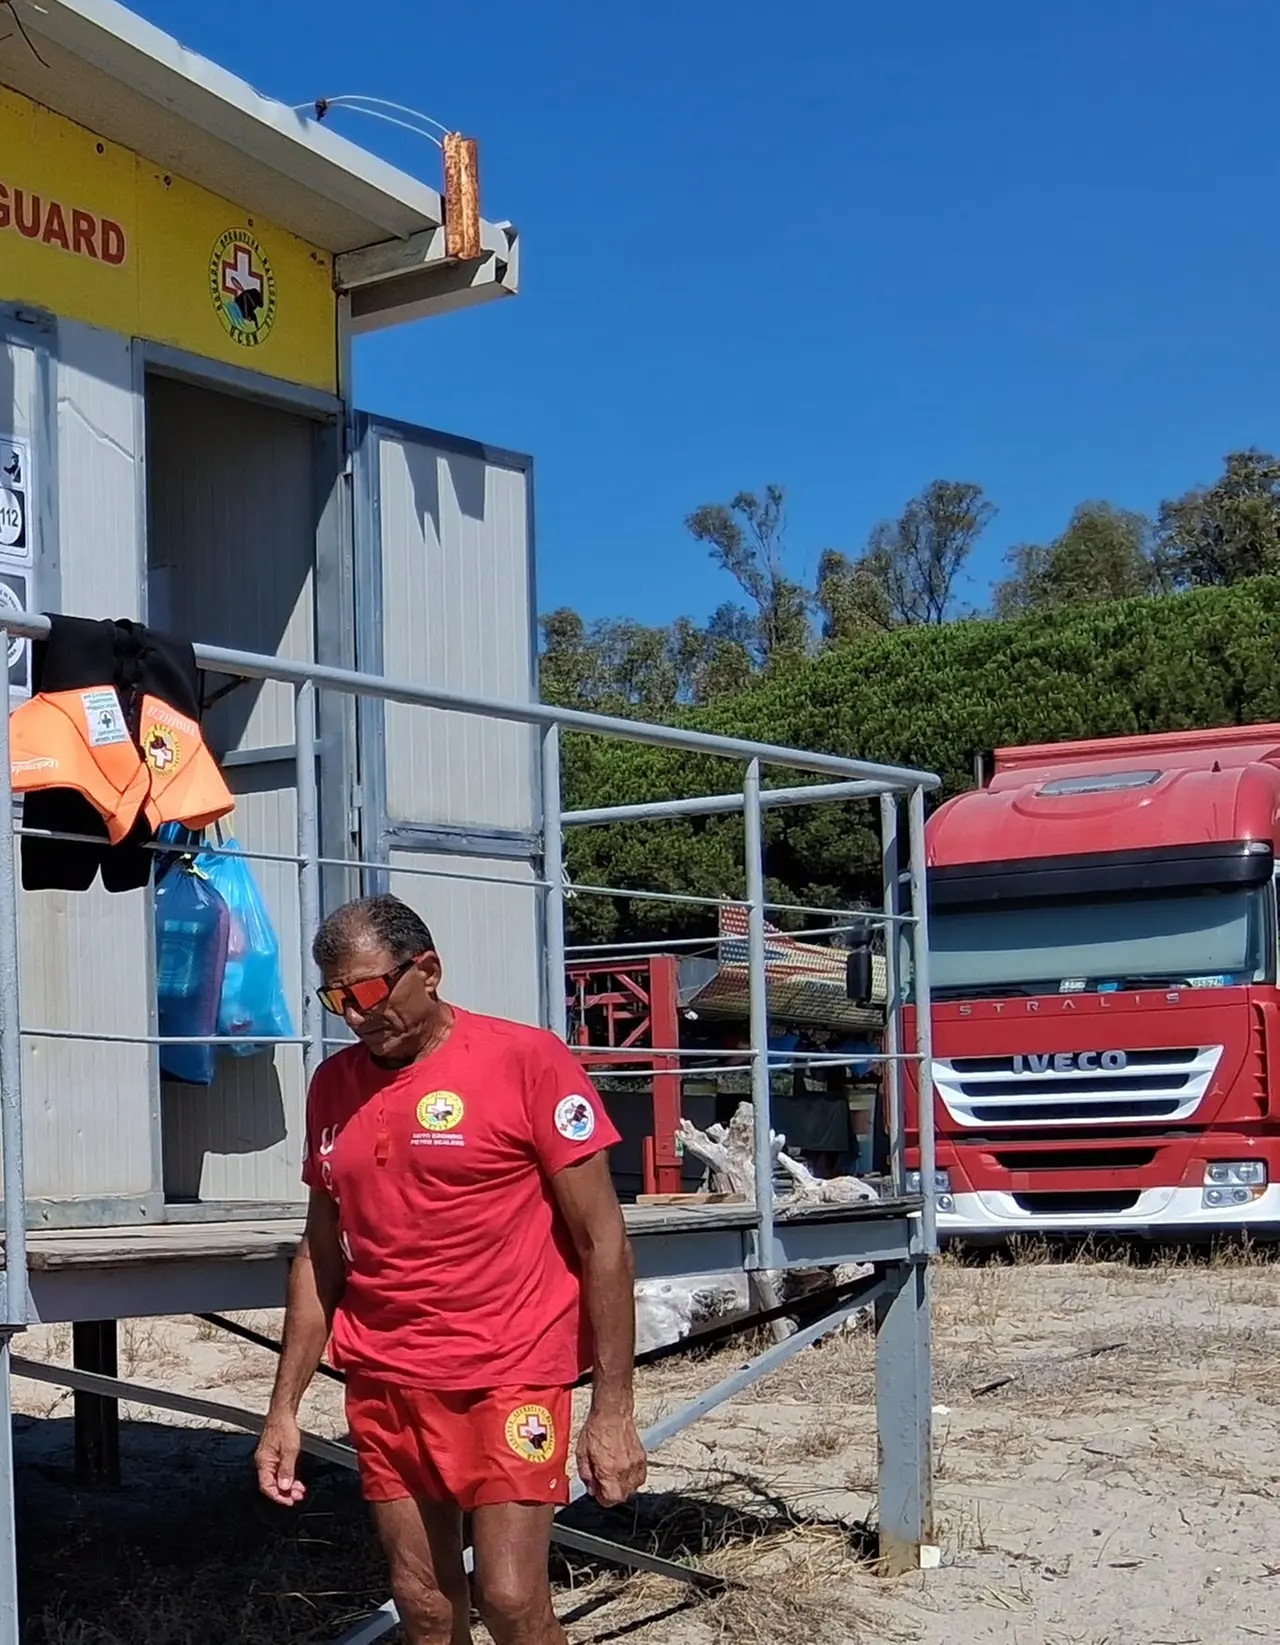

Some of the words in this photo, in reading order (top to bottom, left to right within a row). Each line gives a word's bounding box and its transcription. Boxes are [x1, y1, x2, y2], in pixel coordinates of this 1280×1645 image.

[0, 508, 19, 528] 112
[959, 992, 1180, 1016] STRALIS
[1012, 1050, 1128, 1075] IVECO
